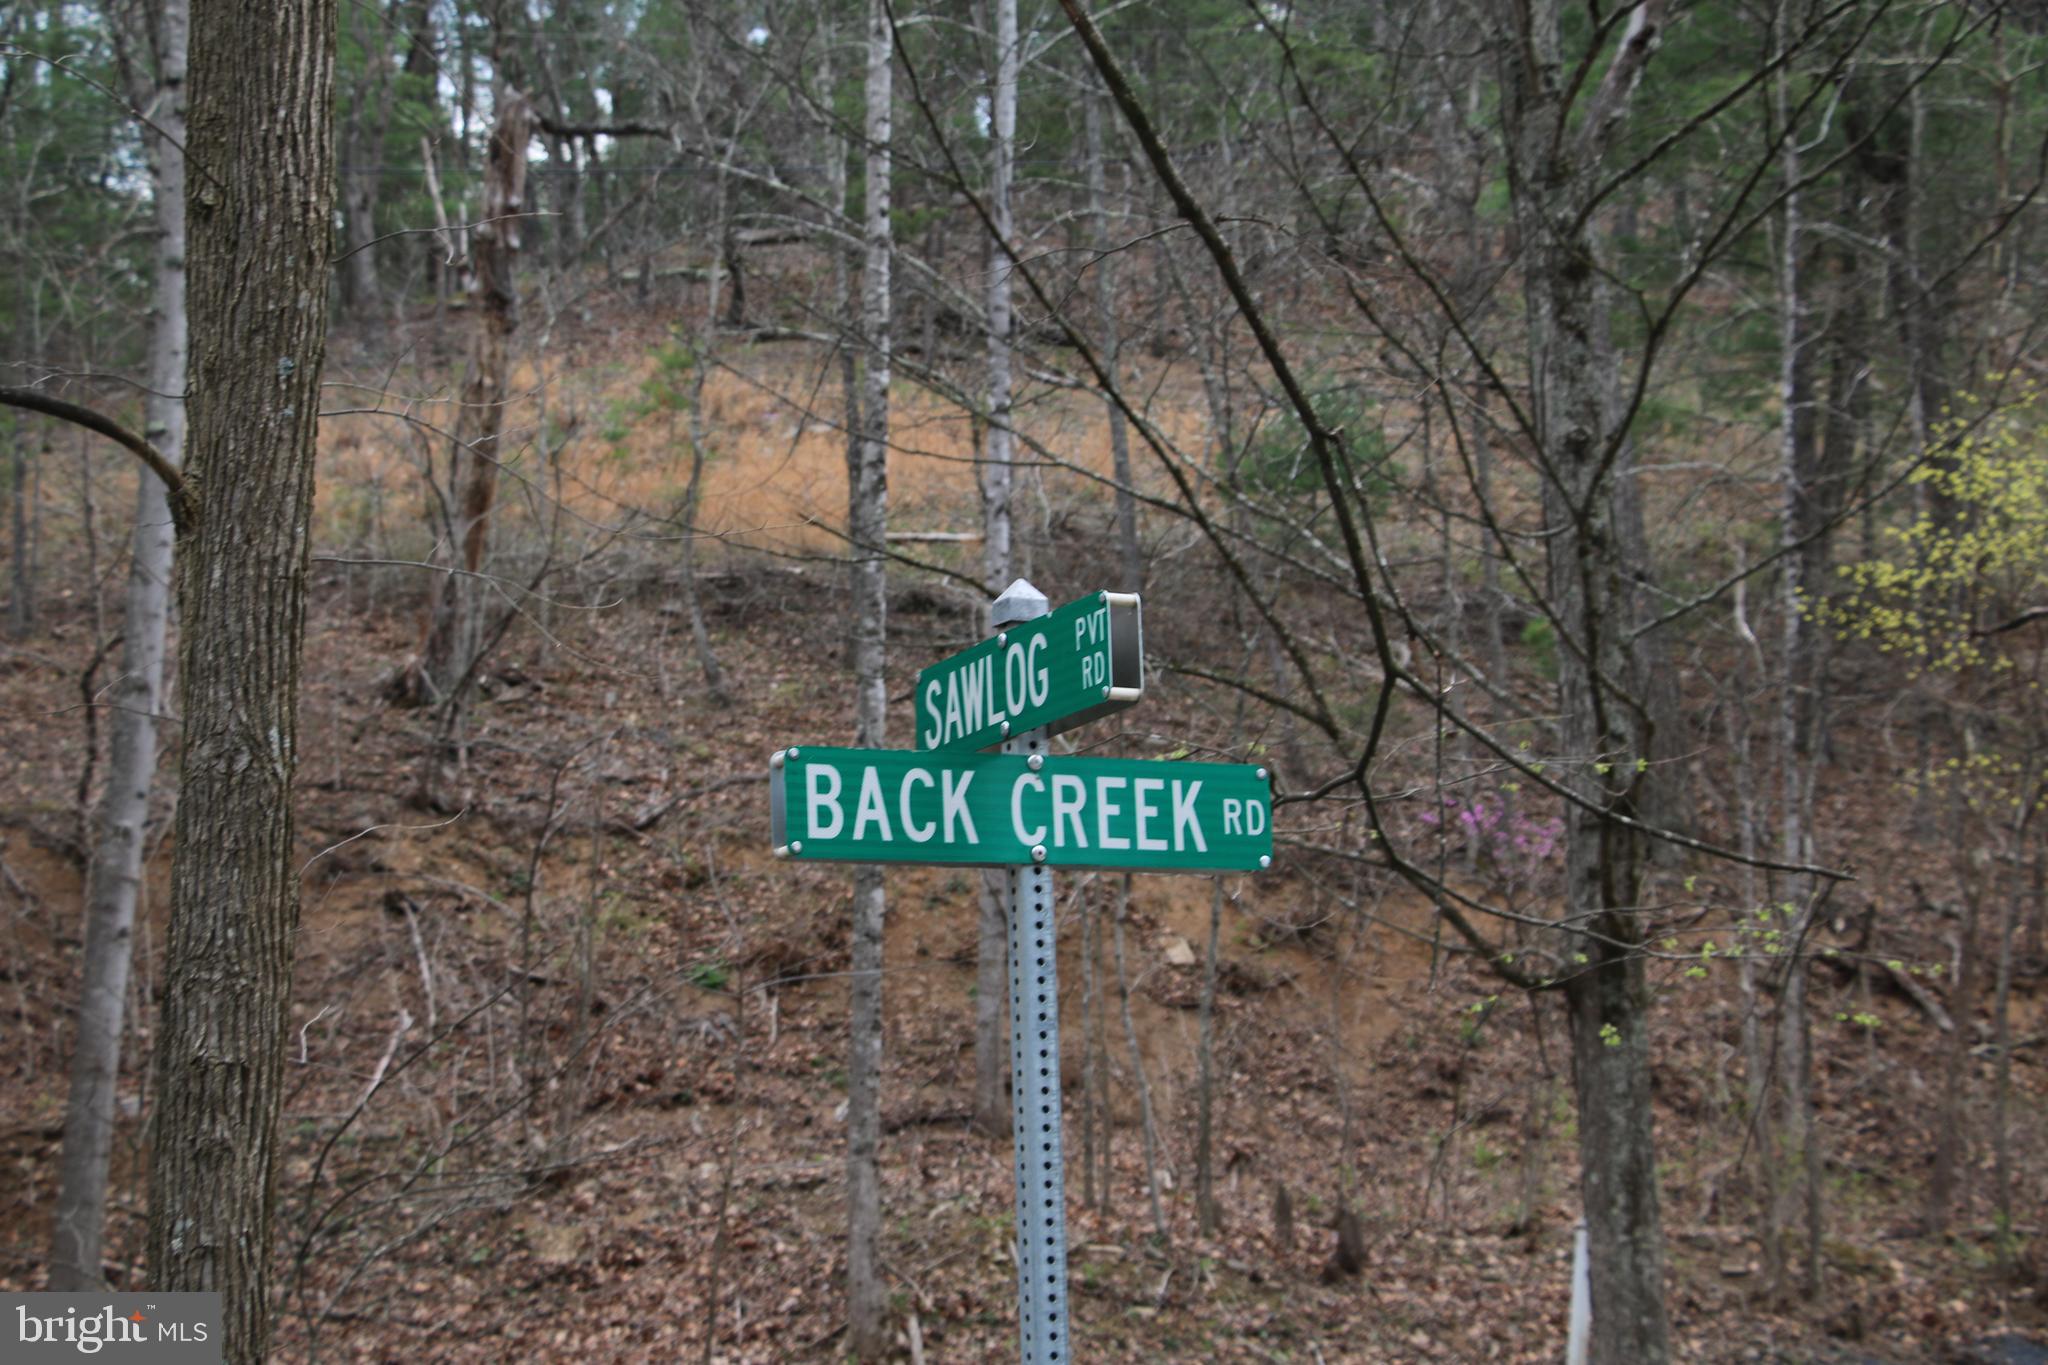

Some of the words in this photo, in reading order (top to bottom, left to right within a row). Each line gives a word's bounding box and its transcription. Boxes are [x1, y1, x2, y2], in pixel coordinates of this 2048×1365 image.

[1075, 607, 1106, 652] PVT
[924, 632, 1049, 751] SAWLOG
[1082, 650, 1105, 691] RD
[805, 763, 979, 845] BACK
[1011, 773, 1208, 853] CREEK
[1223, 799, 1265, 836] RD
